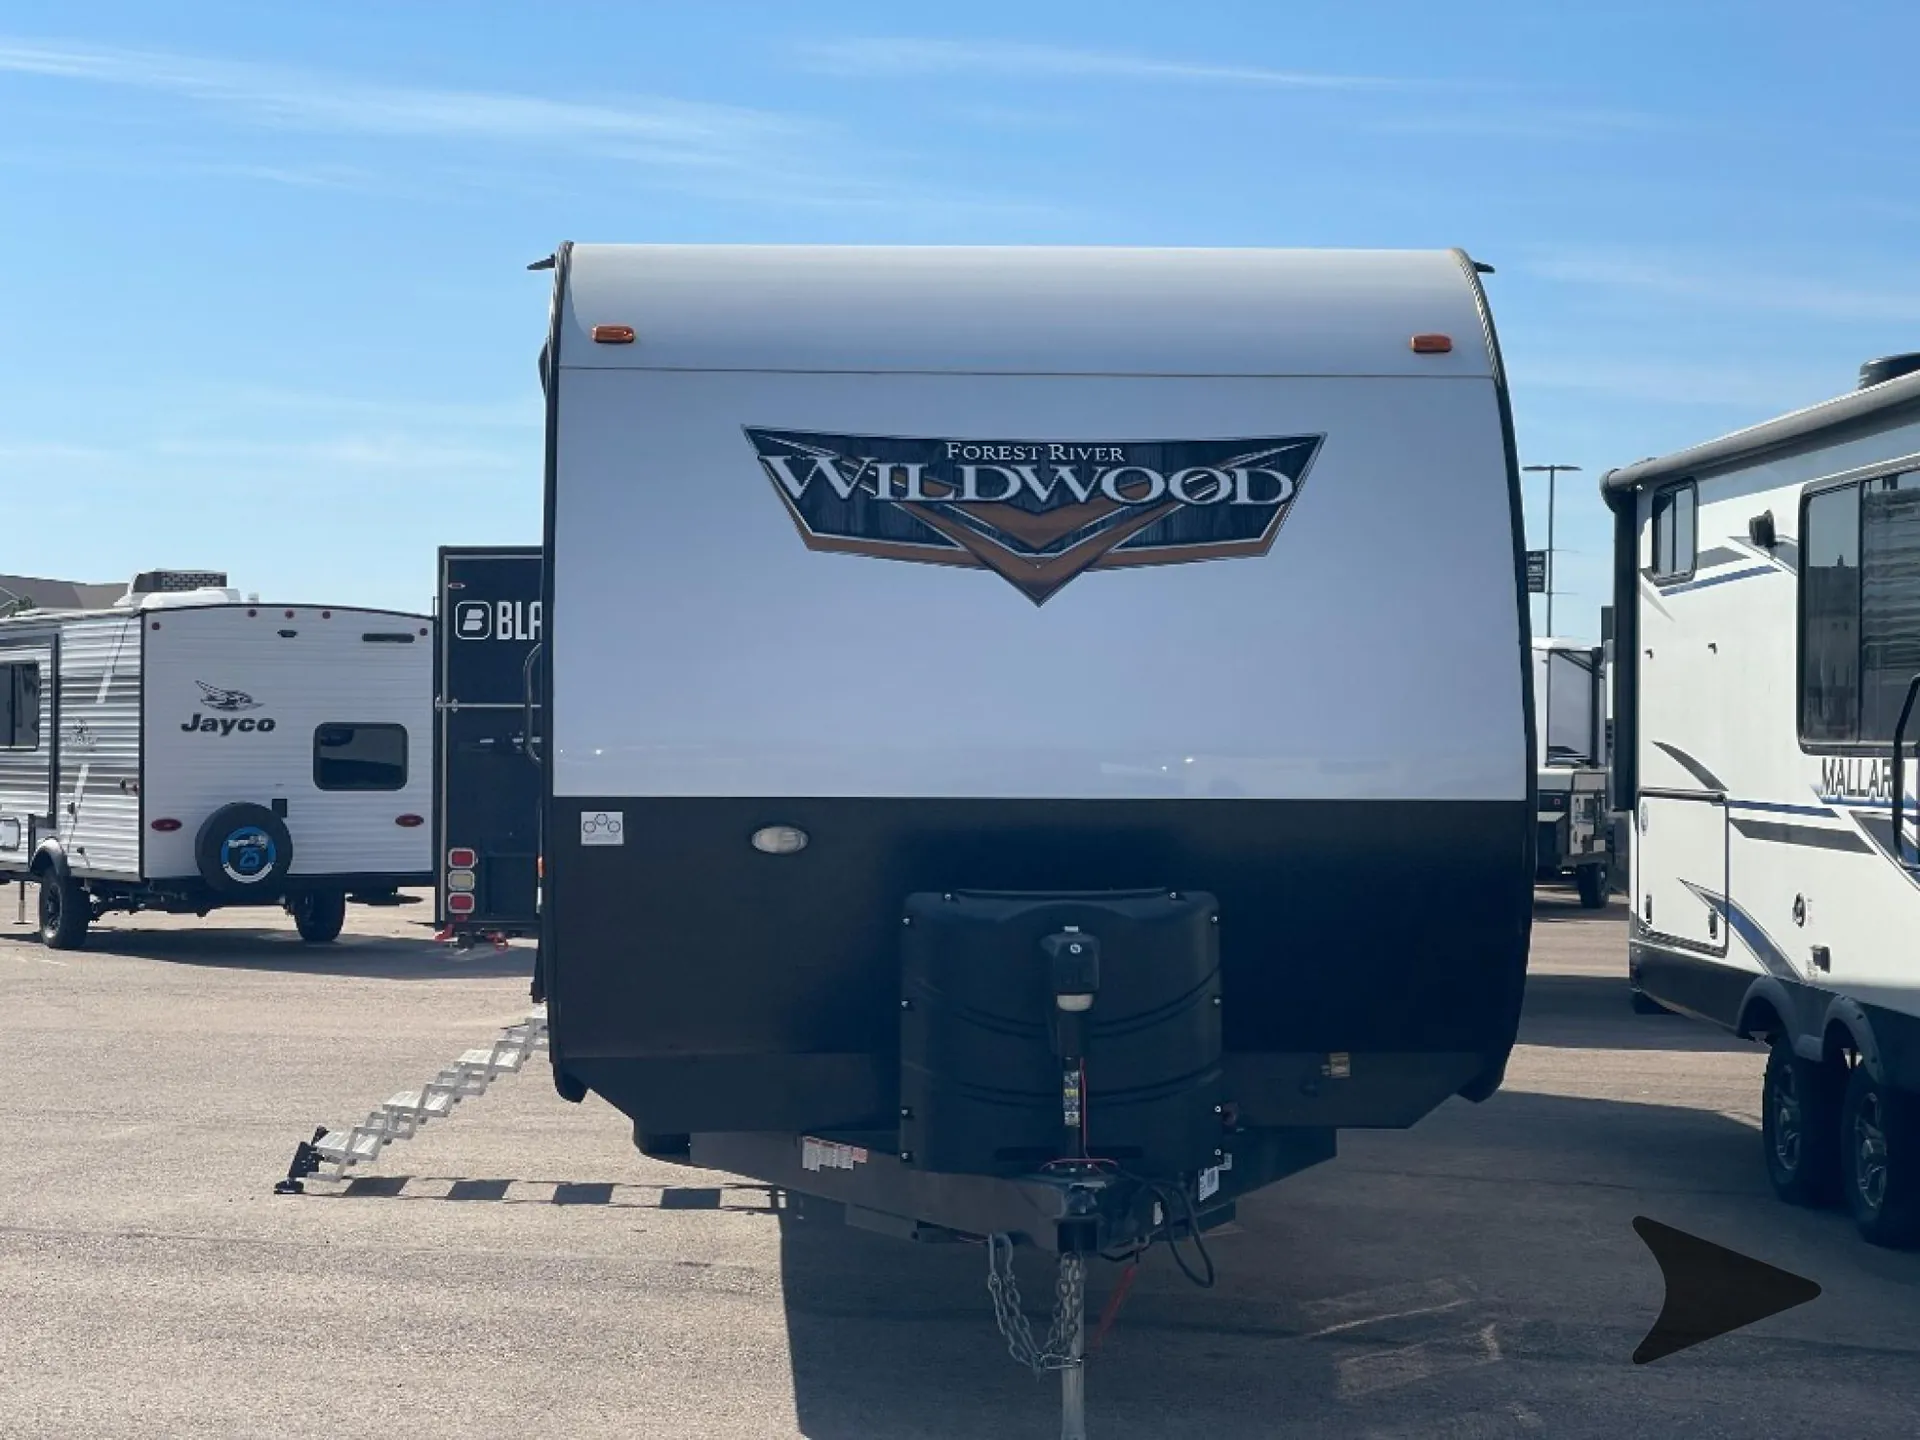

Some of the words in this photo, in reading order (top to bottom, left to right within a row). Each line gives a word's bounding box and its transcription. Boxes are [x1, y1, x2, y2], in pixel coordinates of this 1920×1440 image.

[946, 442, 1043, 461] FOREST
[1049, 444, 1125, 462] RIVER
[757, 455, 1294, 505] WILDWOOD
[180, 712, 276, 737] Jayco
[1821, 757, 1906, 797] MALLAR
